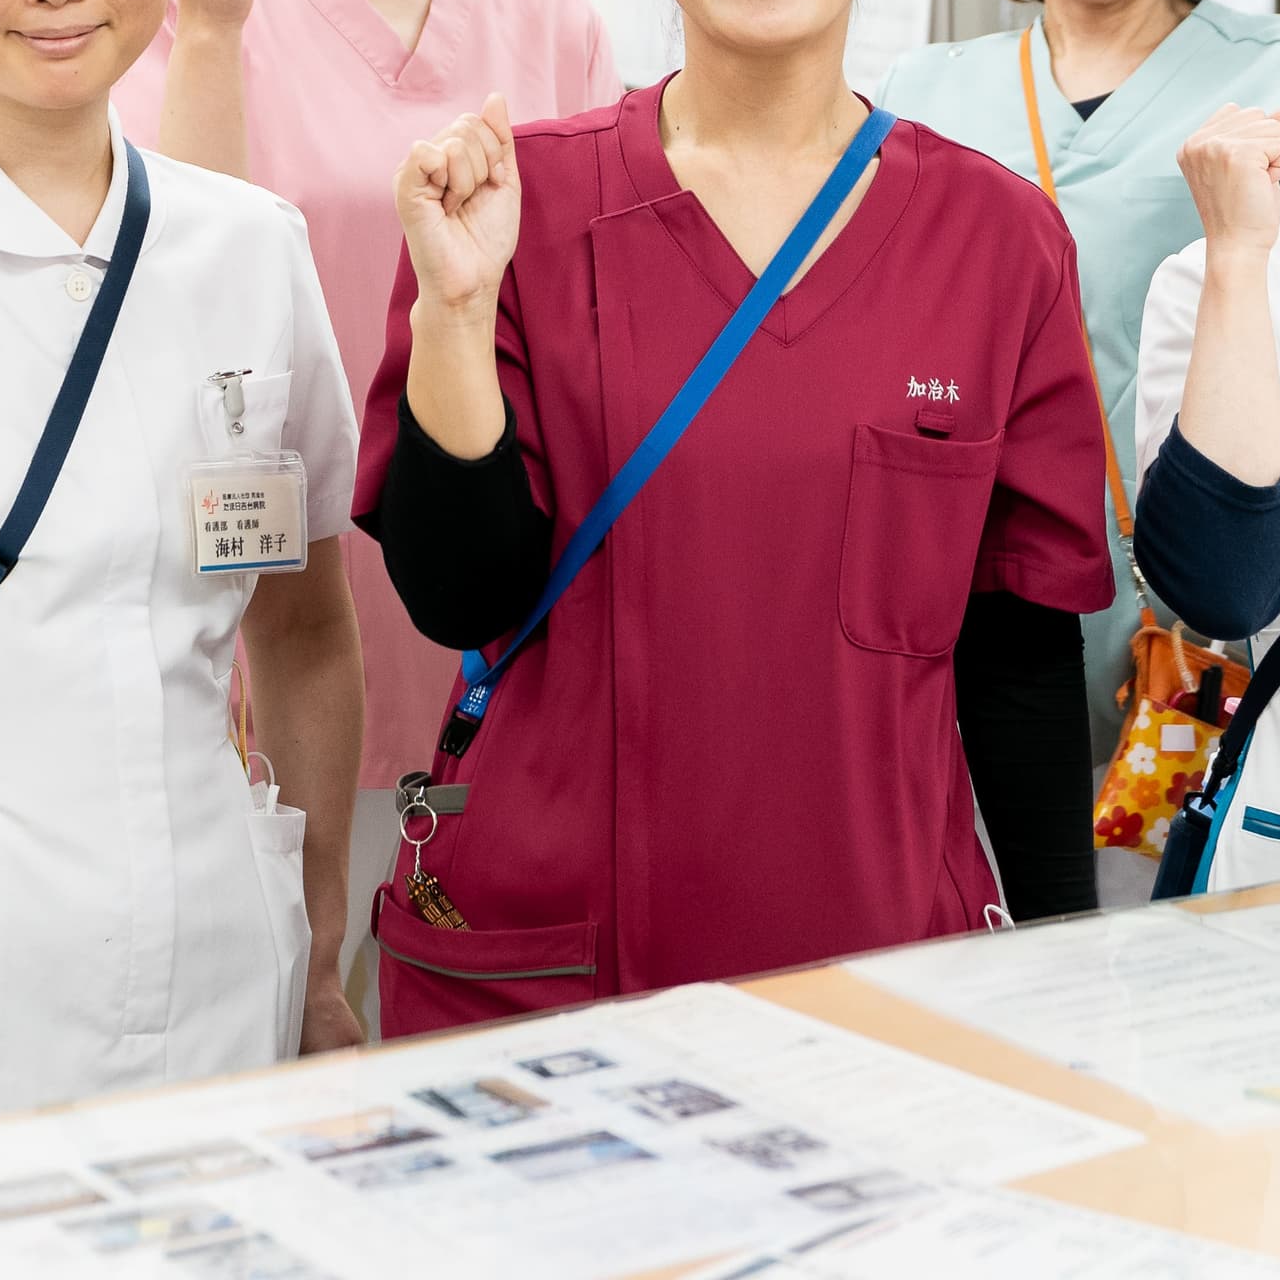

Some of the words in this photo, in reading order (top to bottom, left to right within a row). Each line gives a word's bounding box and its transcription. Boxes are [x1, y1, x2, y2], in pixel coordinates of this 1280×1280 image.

[906, 375, 960, 404] 加治木
[215, 536, 244, 558] 海村
[260, 533, 287, 554] 洋子
